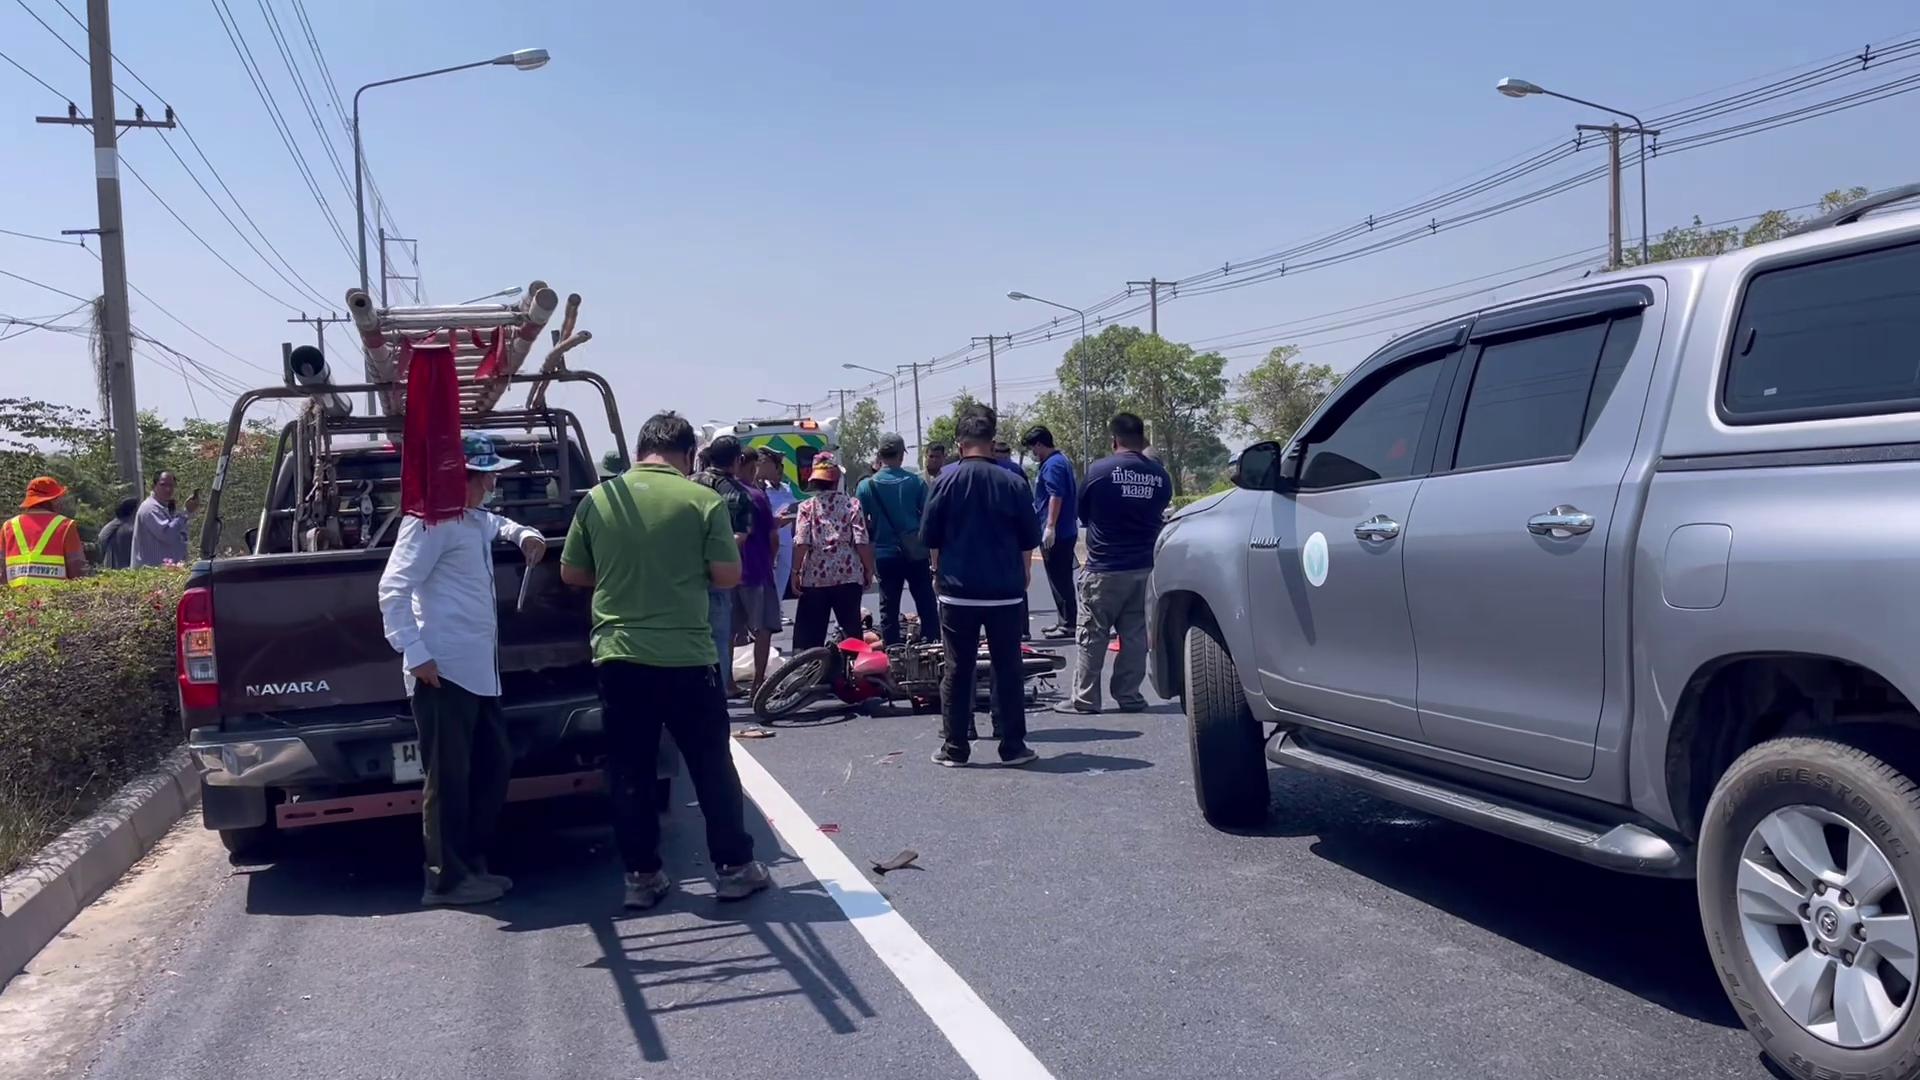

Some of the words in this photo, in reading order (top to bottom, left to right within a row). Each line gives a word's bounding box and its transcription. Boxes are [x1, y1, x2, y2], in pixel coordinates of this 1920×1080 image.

[1121, 485, 1154, 499] พลอย
[1250, 536, 1282, 548] HILUX
[246, 680, 331, 697] NAVARA
